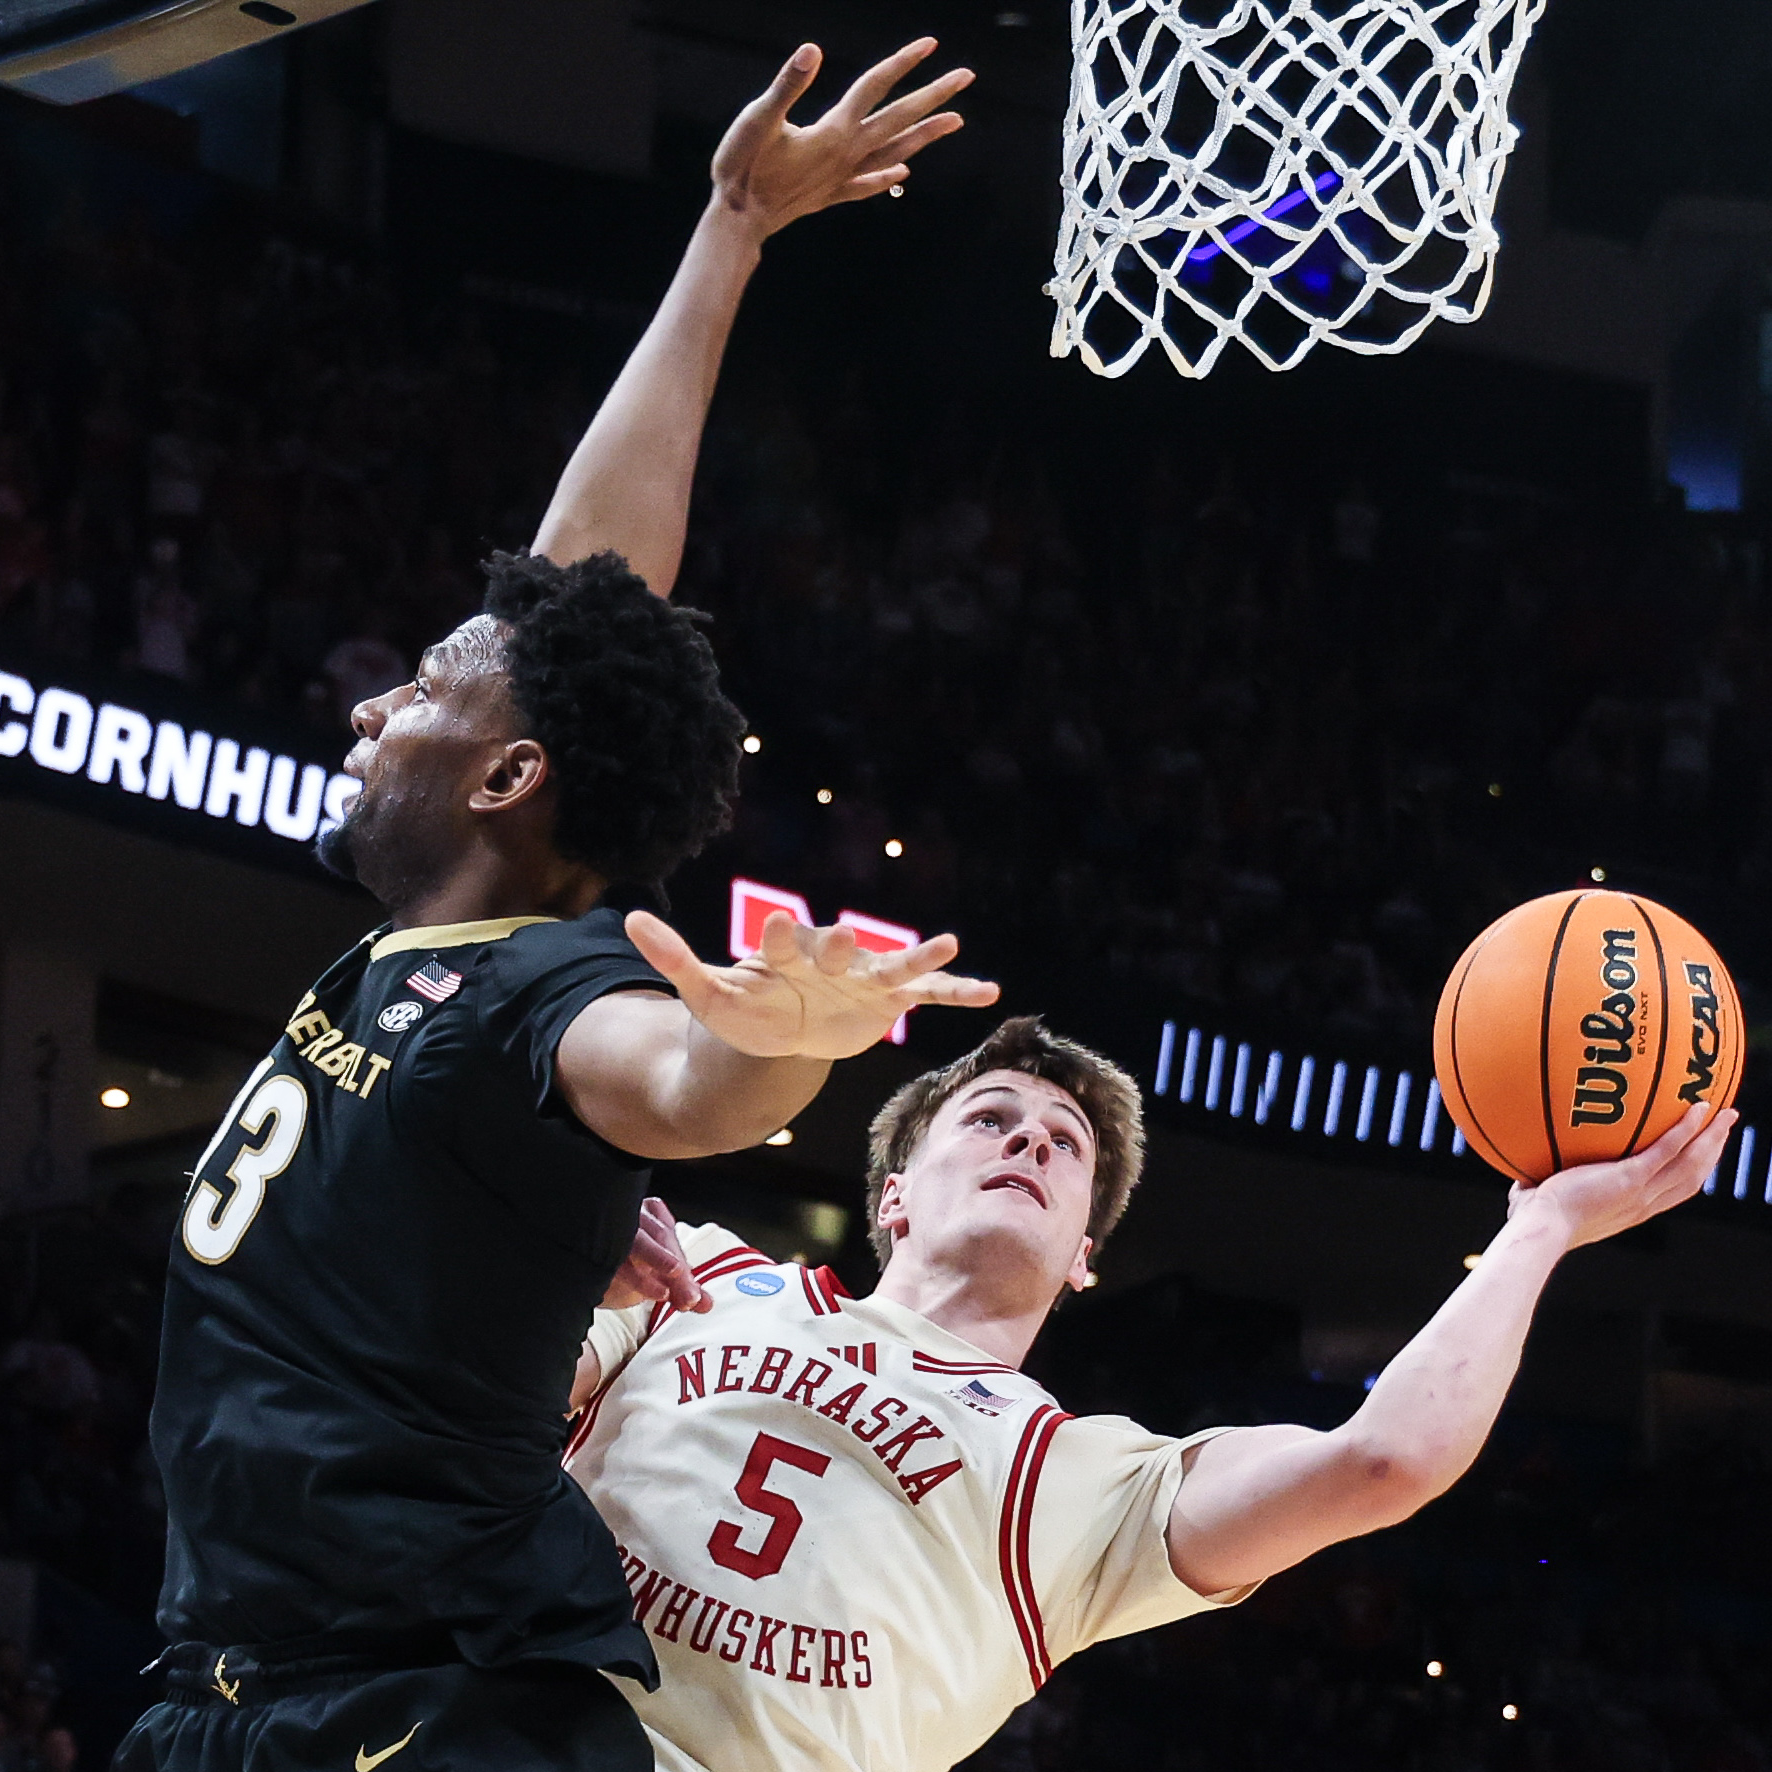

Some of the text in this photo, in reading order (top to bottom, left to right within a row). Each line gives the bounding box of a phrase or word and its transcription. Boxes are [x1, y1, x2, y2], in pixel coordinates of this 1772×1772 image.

[1569, 927, 1639, 1129] Wilson
[1678, 961, 1720, 1103] NCAA
[183, 1056, 308, 1266] 3
[674, 1345, 963, 1506] NEBRASKA
[707, 1431, 832, 1581] 5
